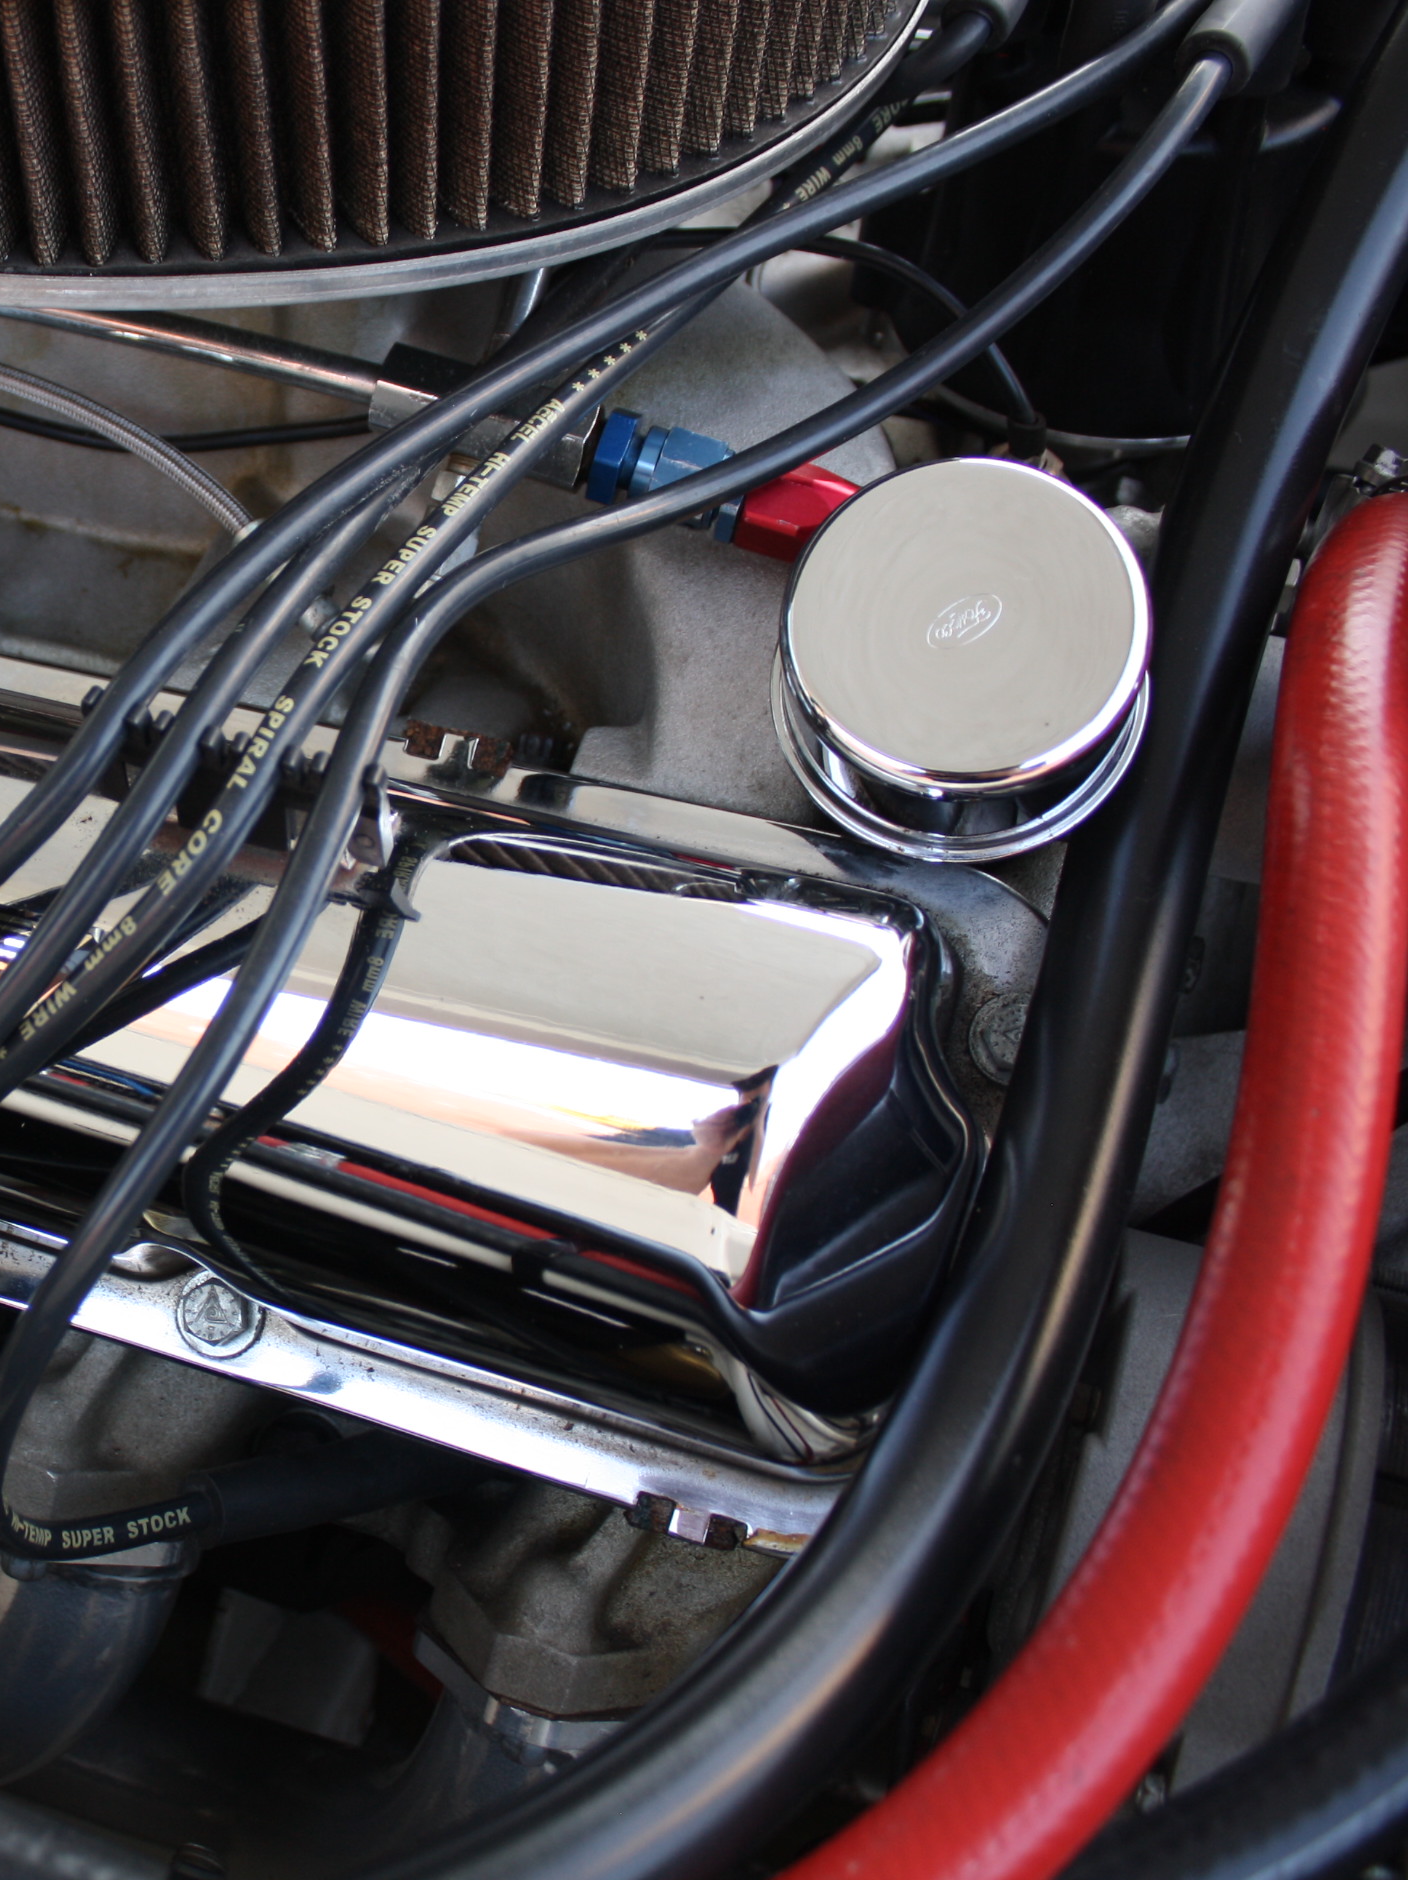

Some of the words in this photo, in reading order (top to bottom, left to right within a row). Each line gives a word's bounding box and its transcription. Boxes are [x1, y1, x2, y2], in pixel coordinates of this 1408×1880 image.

[871, 99, 910, 132] ORE
[832, 134, 863, 166] 8mm
[794, 166, 831, 201] WIRE
[510, 398, 565, 443] ACCEL
[442, 451, 511, 517] HI-TEMP
[371, 524, 437, 586] SUPER
[304, 596, 373, 669] STOCK
[226, 694, 295, 790] SPIRAL
[156, 808, 223, 895] CORE
[83, 915, 137, 971] 8mm
[18, 981, 77, 1041] WIRE
[61, 1526, 115, 1550] SUPER
[127, 1505, 192, 1540] STOCK
